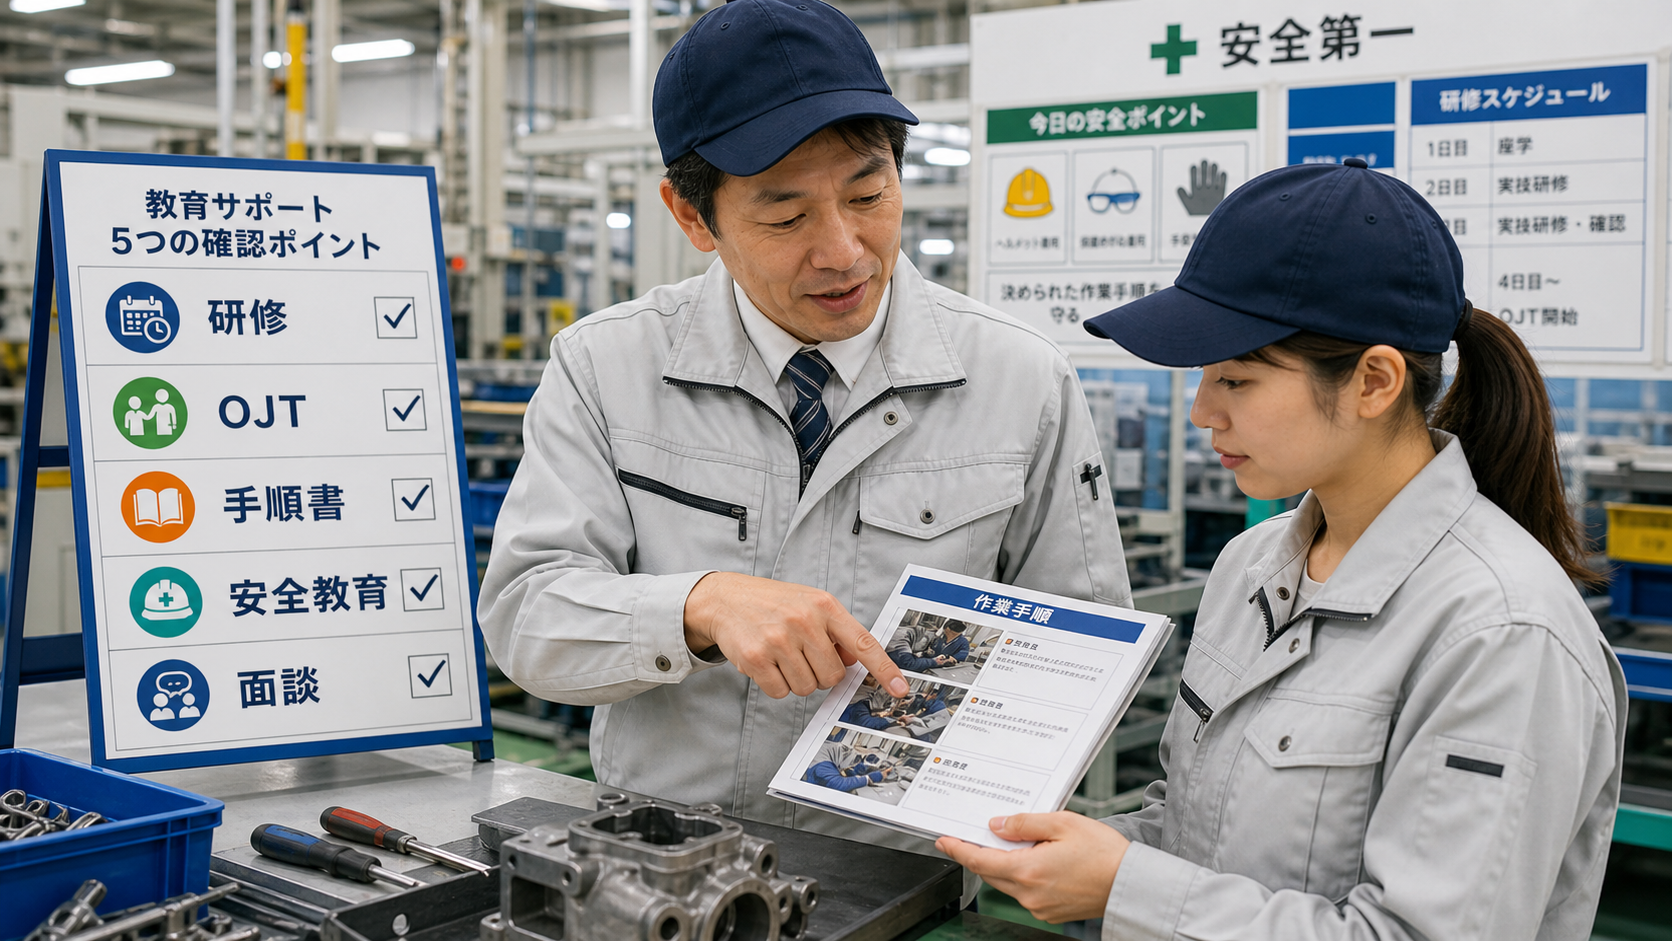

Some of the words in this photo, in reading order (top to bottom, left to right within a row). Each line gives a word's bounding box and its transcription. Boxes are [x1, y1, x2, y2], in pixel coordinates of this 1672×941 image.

[1220, 14, 1415, 69] 安全第一
[1439, 81, 1612, 113] 研修スケジュール
[1028, 101, 1207, 137] 今日の安全ポイント
[1427, 139, 1468, 157] 1日目
[1498, 136, 1533, 155] 座学
[1425, 178, 1467, 196] 2日目
[1498, 175, 1568, 194] 実技研修
[144, 187, 333, 223] 教育サポート
[1498, 214, 1627, 235] 実技研修・確認
[111, 225, 382, 261] 5つの確認ポイント
[207, 298, 288, 336] 研修
[1050, 306, 1081, 325] 守る
[1500, 307, 1578, 326] OJT開始
[218, 394, 307, 430] OJT
[223, 483, 346, 524] 手順書
[229, 574, 388, 618] 安全教育
[973, 593, 1055, 625] 作業手順
[237, 666, 321, 710] 面談
